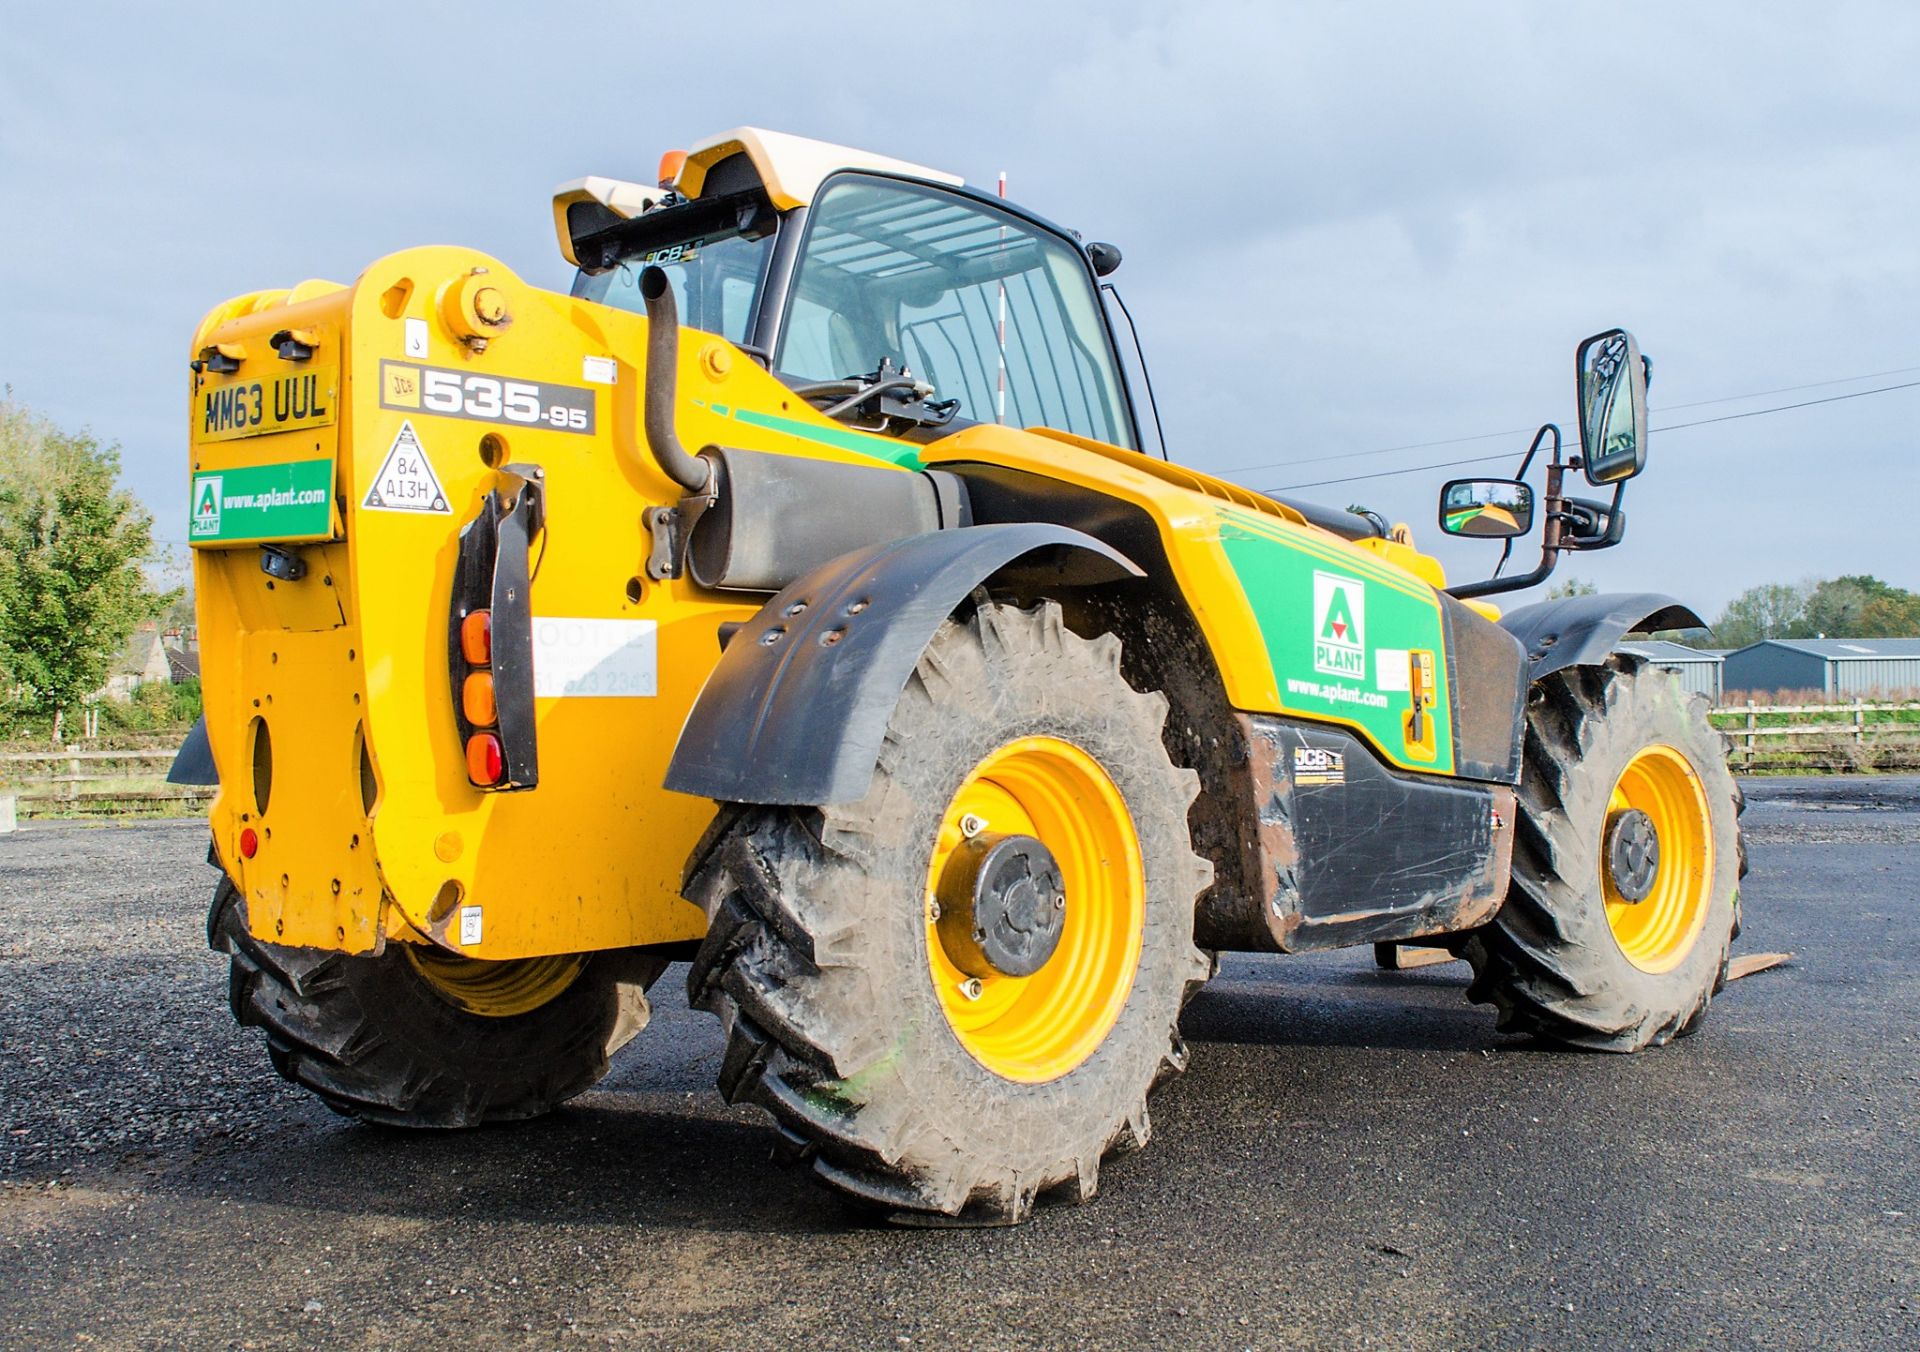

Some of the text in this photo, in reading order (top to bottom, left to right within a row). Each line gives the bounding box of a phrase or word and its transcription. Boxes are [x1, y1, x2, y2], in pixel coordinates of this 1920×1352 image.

[205, 374, 326, 433] MM63 UUL
[397, 457, 418, 477] 84
[223, 488, 326, 512] www.aplant.com
[193, 519, 219, 532] PLANT
[1316, 645, 1363, 673] PLANT
[1287, 678, 1389, 709] www.aplant.com
[1295, 748, 1328, 766] JCB
